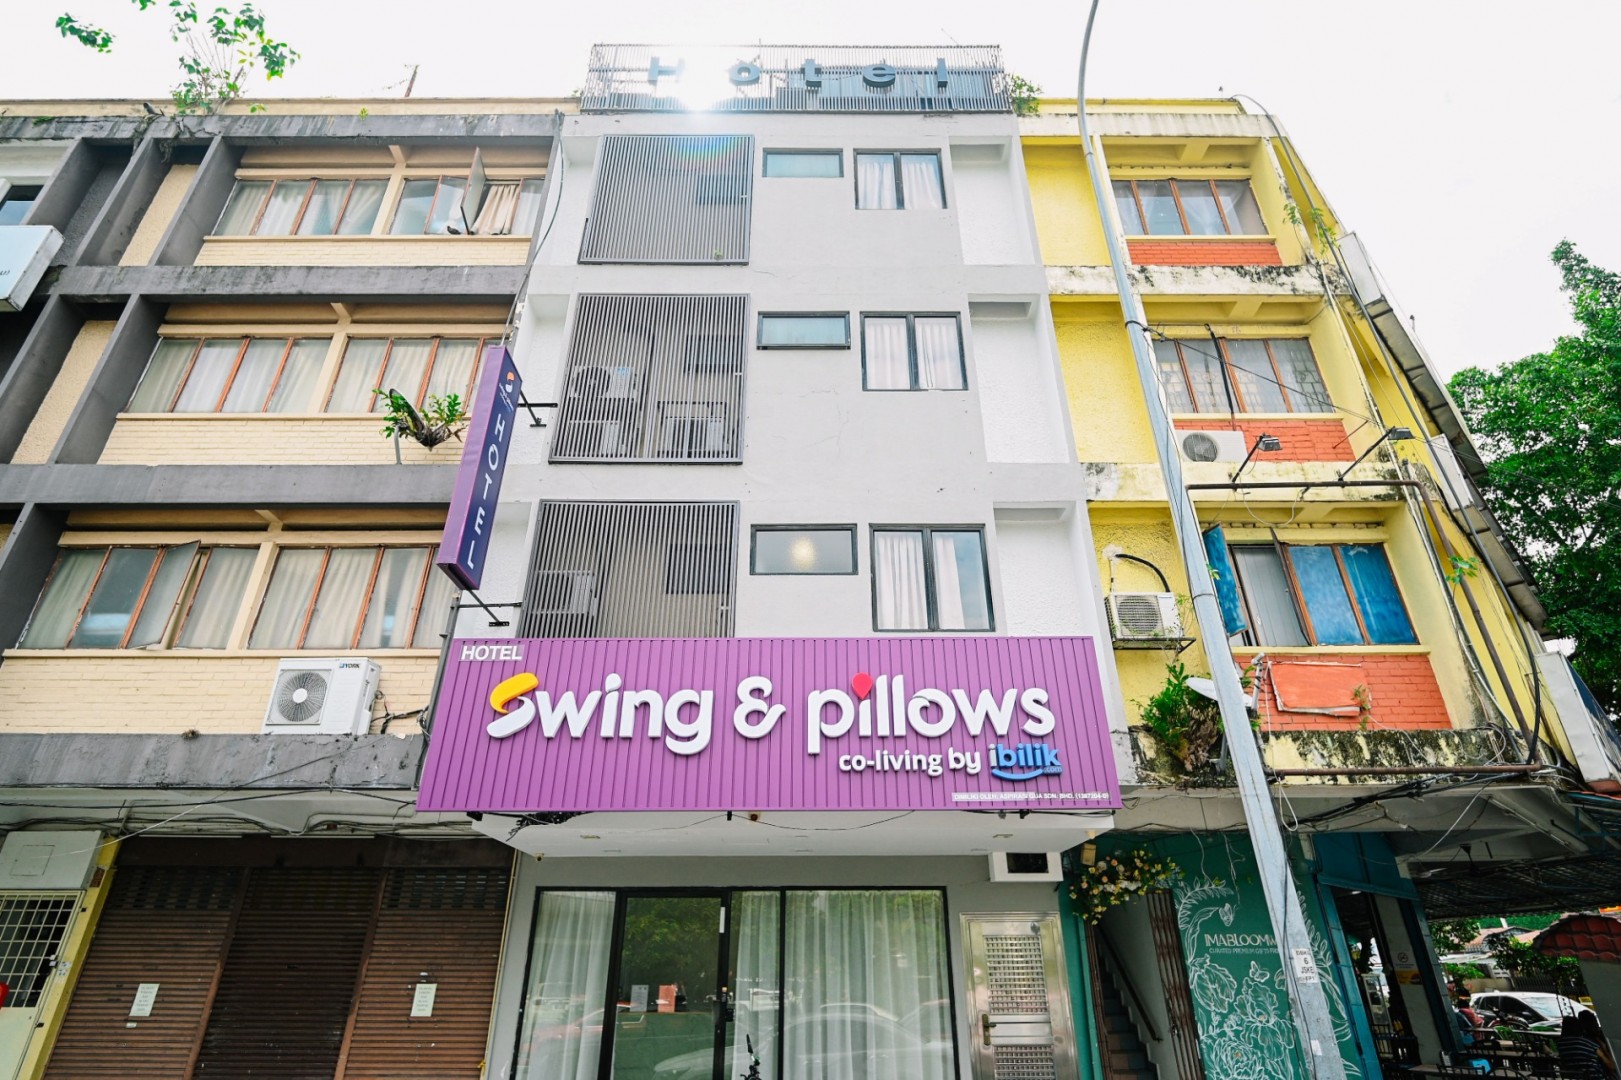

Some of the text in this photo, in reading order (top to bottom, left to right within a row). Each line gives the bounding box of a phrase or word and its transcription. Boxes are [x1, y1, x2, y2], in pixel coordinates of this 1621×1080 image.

[647, 56, 949, 88] Hotel
[467, 413, 506, 570] HOTEL
[460, 645, 523, 661] HOTEL
[486, 672, 1056, 756] Swing & pillows
[839, 743, 1062, 777] co-living by ibilik
[1303, 957, 1309, 965] 6
